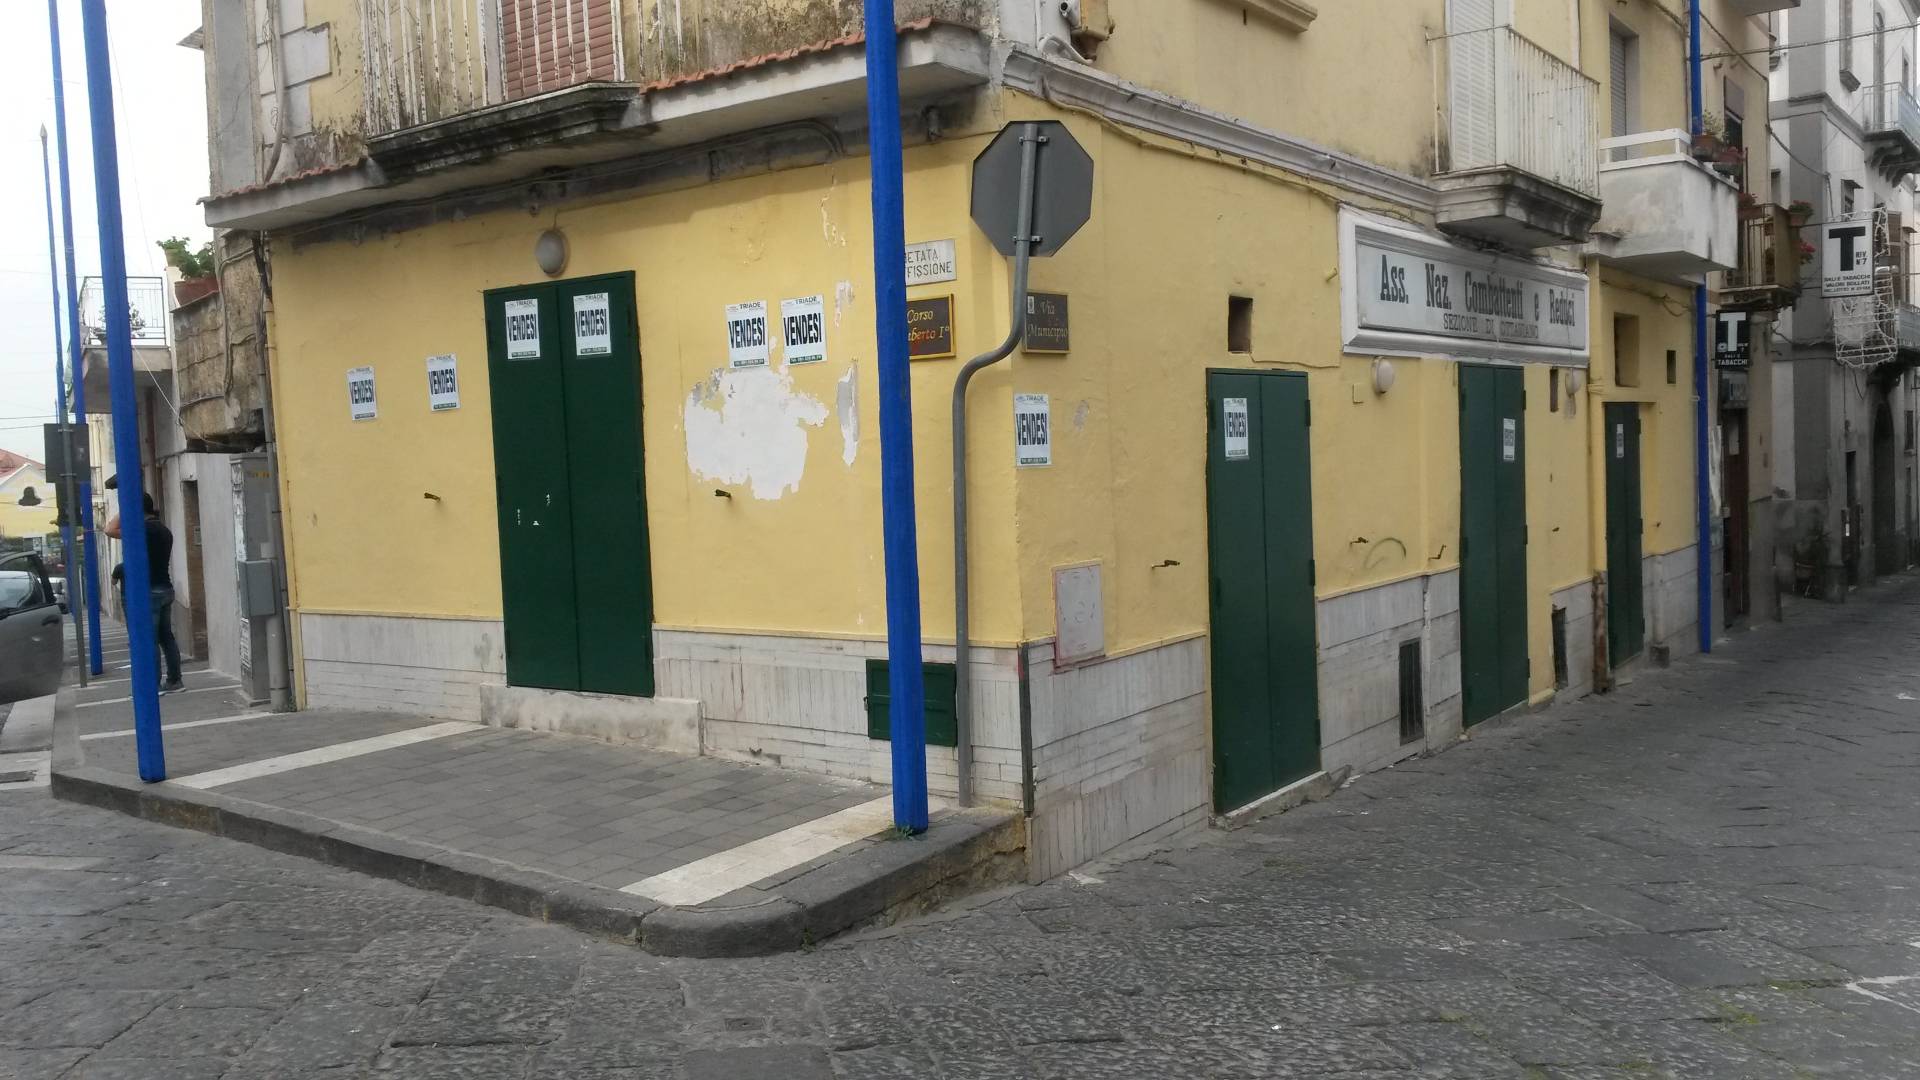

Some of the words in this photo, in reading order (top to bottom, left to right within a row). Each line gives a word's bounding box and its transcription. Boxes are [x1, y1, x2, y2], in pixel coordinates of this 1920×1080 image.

[907, 249, 939, 263] ETATA
[1829, 226, 1866, 271] T
[907, 261, 952, 278] FISSIONE
[1380, 254, 1409, 304] Ass.
[1425, 263, 1452, 310] Naz.
[1464, 271, 1524, 320] Combattenti
[1533, 292, 1540, 321] e
[1549, 289, 1576, 327] Reduci
[739, 301, 761, 310] TRIADE
[906, 309, 934, 323] Corso
[507, 313, 538, 342] VENDESI
[575, 308, 608, 338] VENDESI
[728, 316, 766, 349] VENDESI
[783, 312, 822, 347] VENDESI
[1720, 311, 1747, 352] T
[349, 379, 375, 405] VENDESI
[428, 368, 456, 395] VENDESI
[1016, 413, 1048, 446] VENDESI
[1225, 411, 1247, 438] VENDESI
